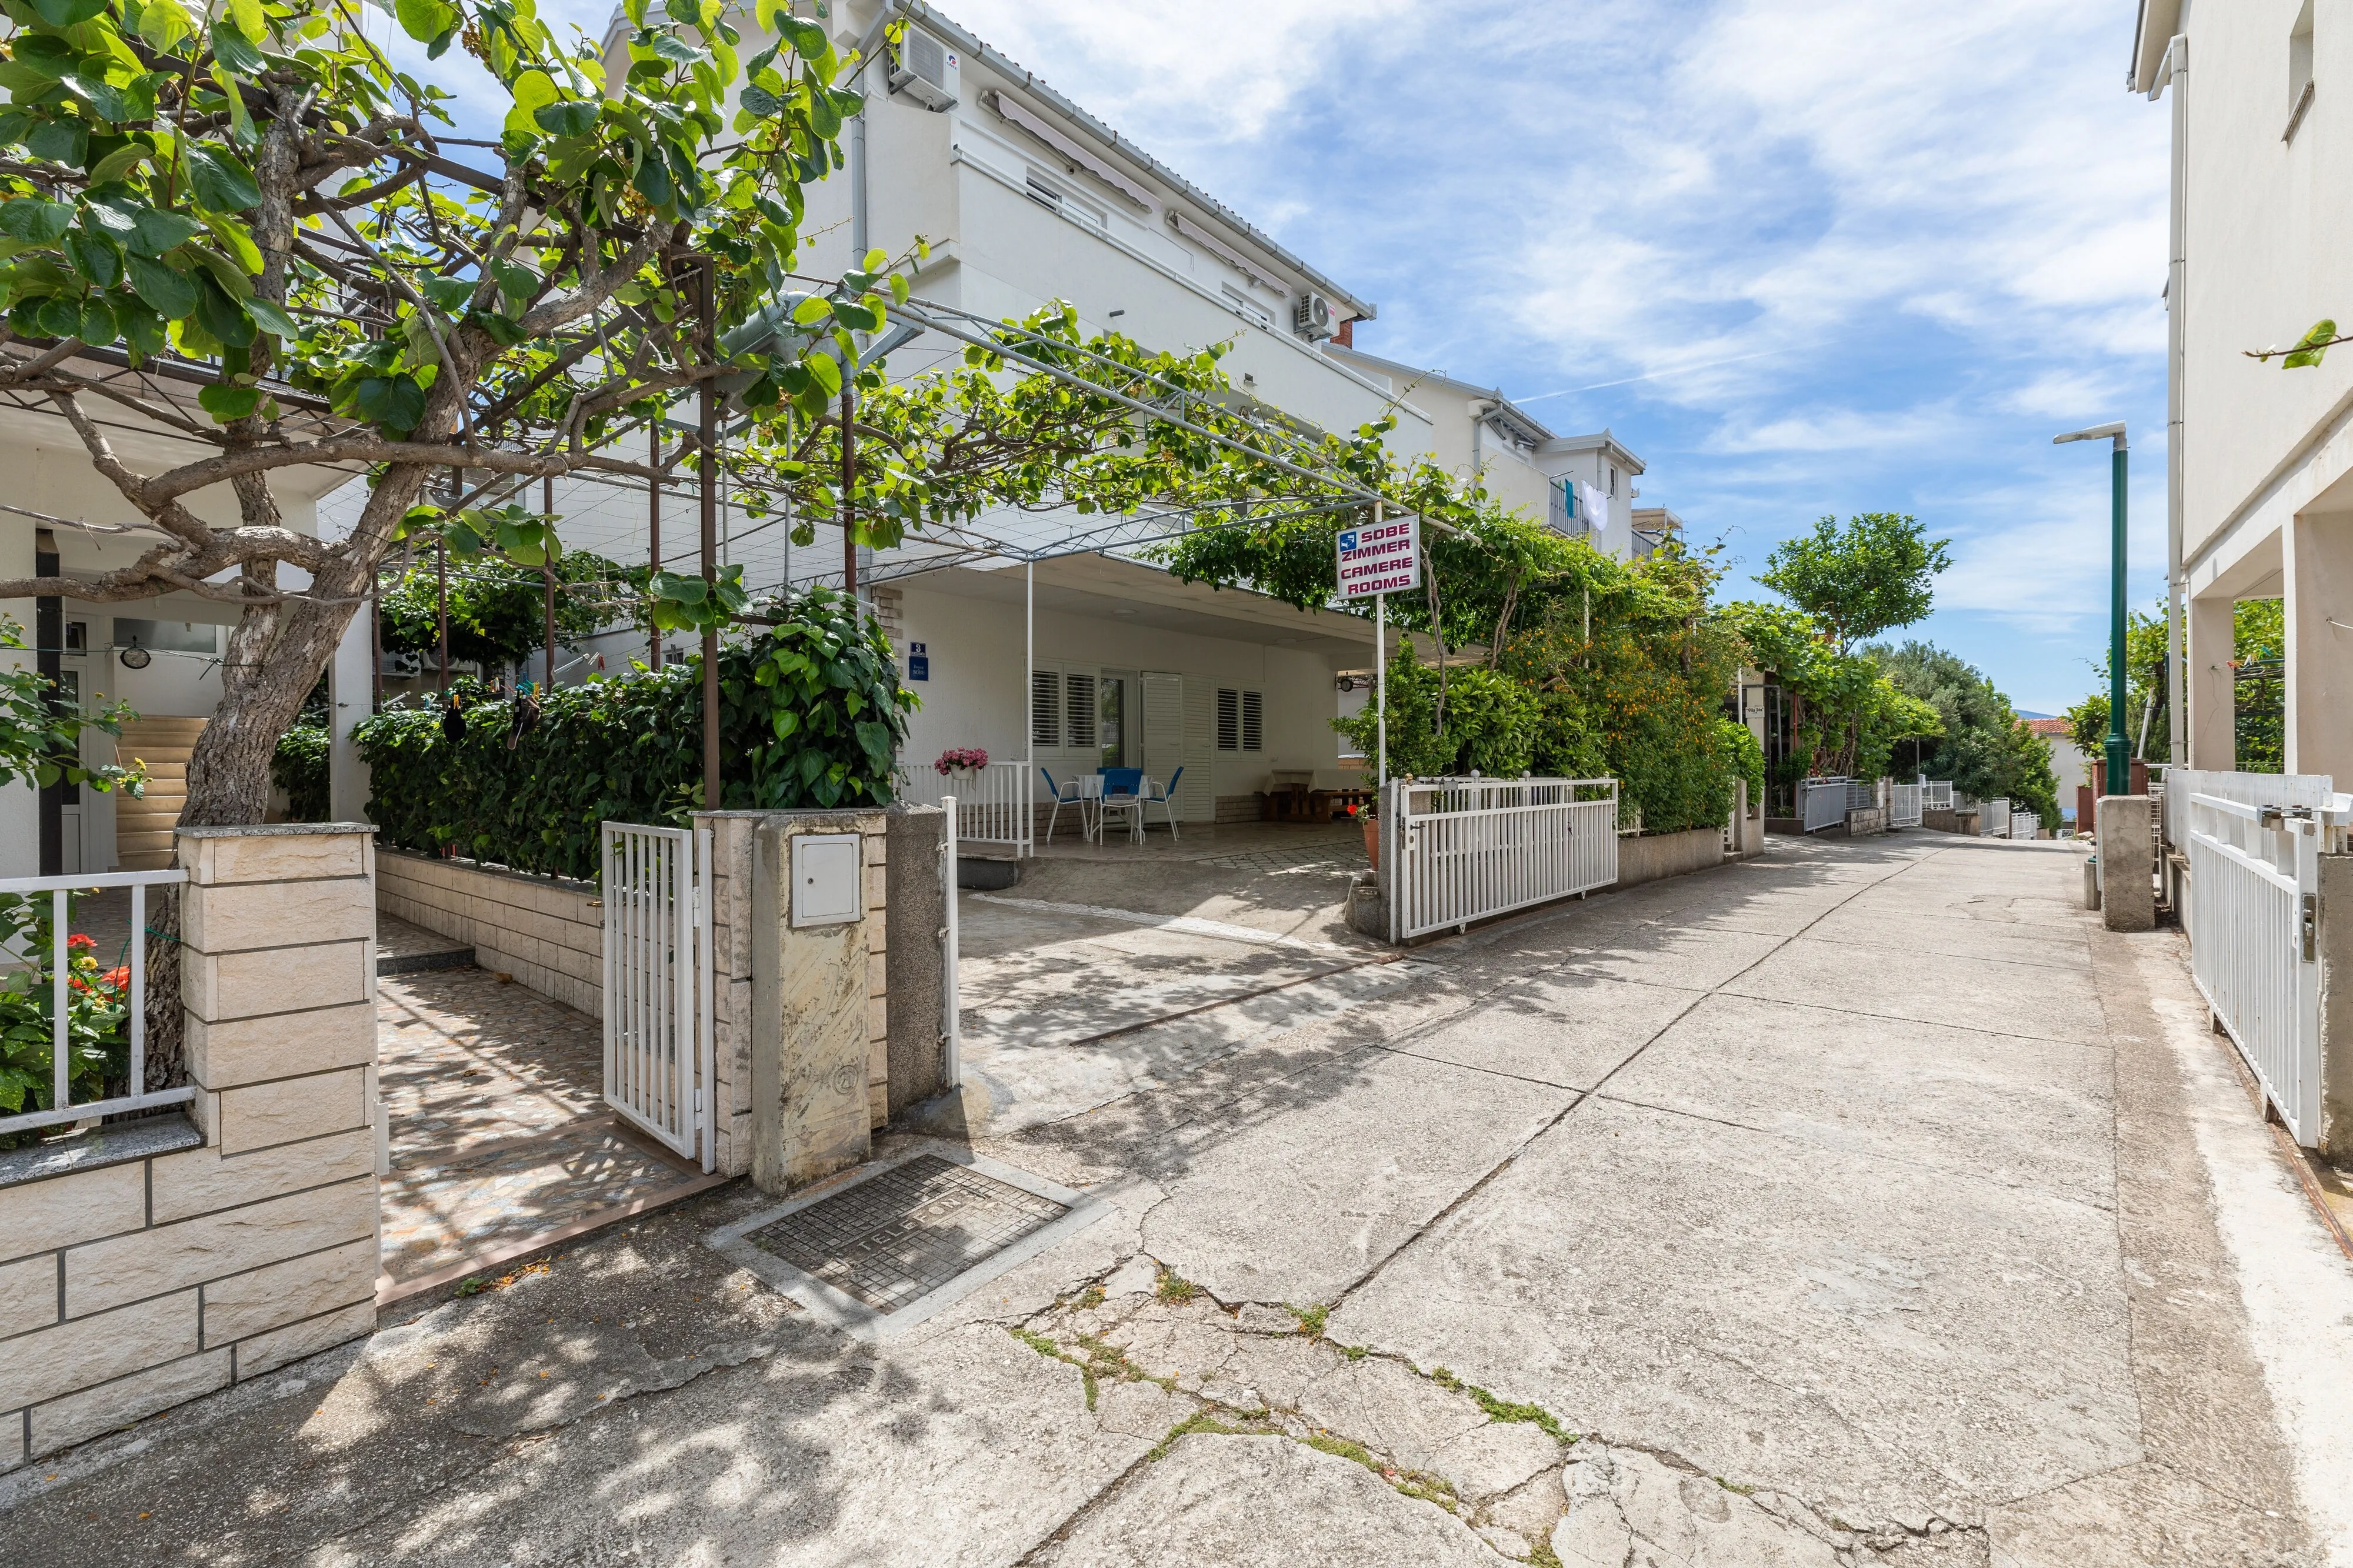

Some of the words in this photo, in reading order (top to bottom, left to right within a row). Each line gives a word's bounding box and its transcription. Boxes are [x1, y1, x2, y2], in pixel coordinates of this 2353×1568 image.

[1361, 523, 1409, 543] SOBE
[1341, 539, 1410, 562] ZIMMER
[1341, 556, 1412, 580] CAMERE
[1348, 574, 1411, 595] ROOMS
[915, 643, 921, 652] 3
[857, 1198, 961, 1252] TELEFON
